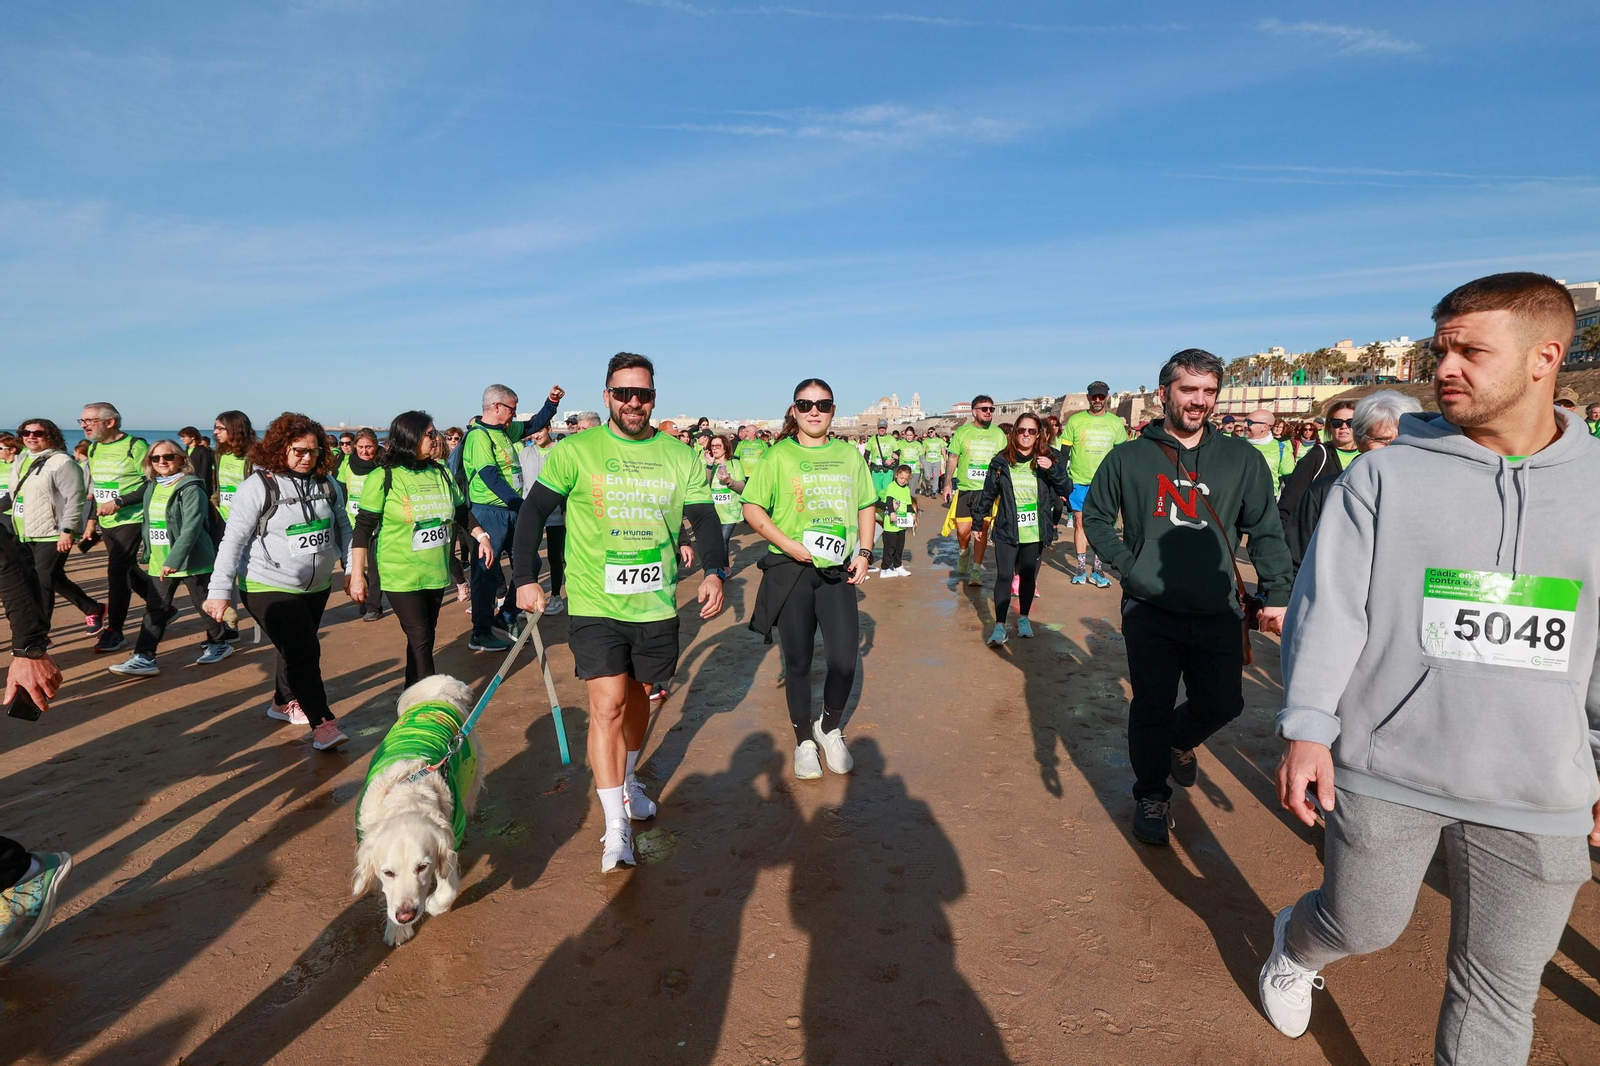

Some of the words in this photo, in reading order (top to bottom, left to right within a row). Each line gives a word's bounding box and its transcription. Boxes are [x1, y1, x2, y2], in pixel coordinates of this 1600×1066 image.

[606, 474, 622, 485] En
[626, 478, 675, 490] marcha
[803, 474, 817, 483] En
[95, 490, 118, 498] 3876
[606, 490, 656, 503] contra
[658, 492, 672, 505] el
[607, 503, 670, 520] cáncer
[299, 531, 330, 548] 2695
[422, 526, 448, 543] 2861
[815, 536, 845, 556] 4761
[617, 566, 660, 585] 4762
[1429, 577, 1460, 585] contra
[1430, 569, 1456, 577] Cádiz
[1454, 608, 1566, 651] 5048
